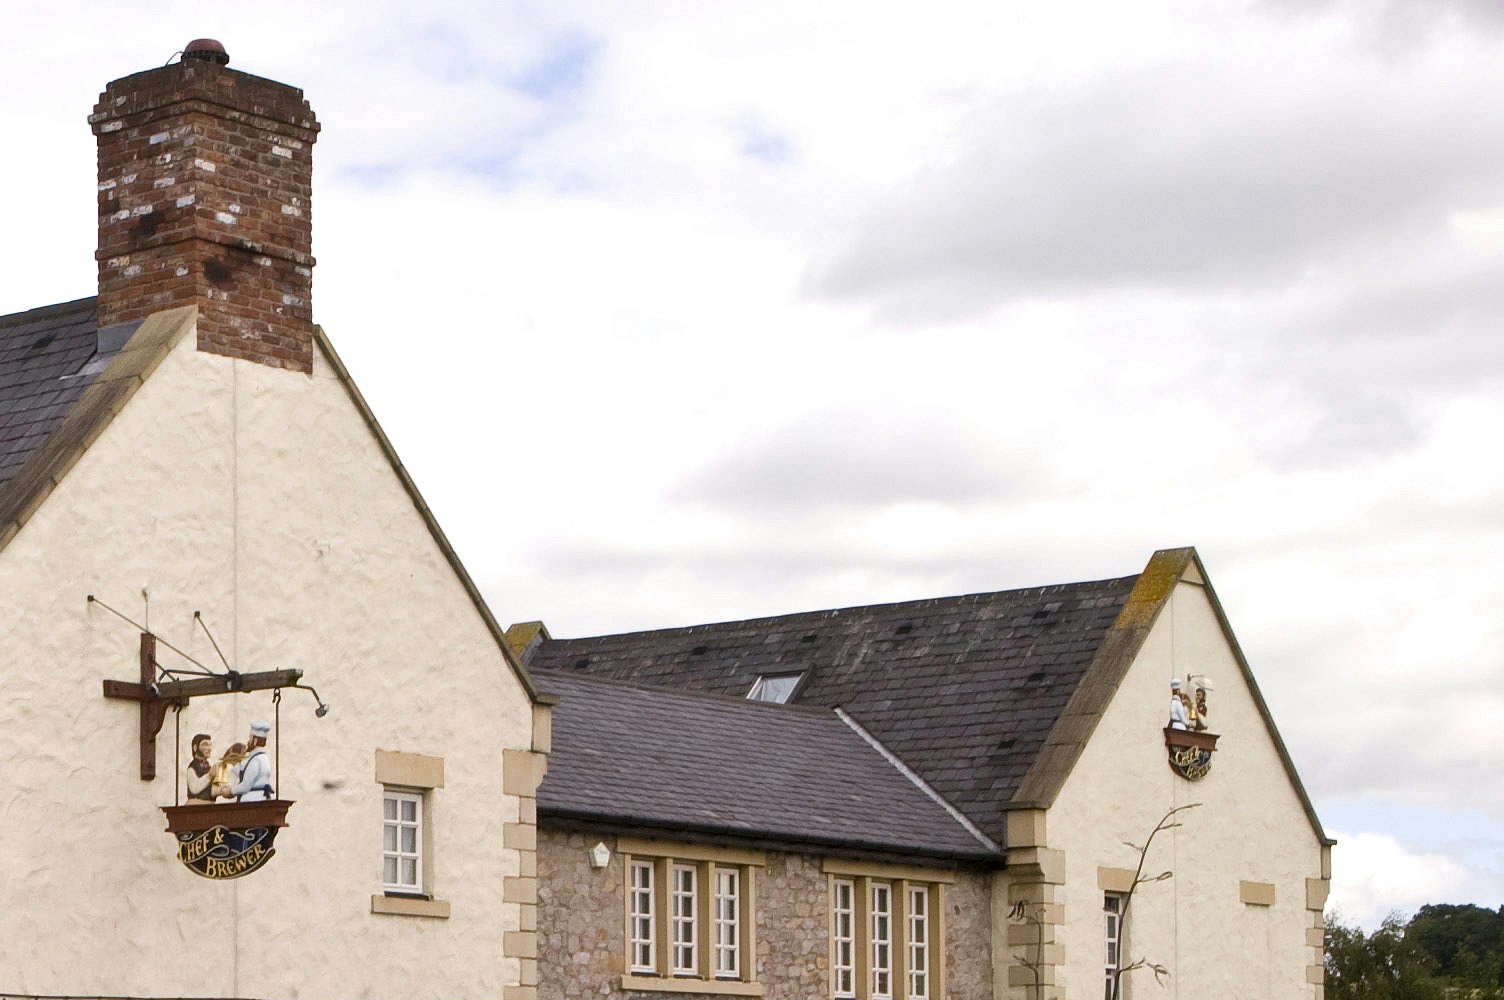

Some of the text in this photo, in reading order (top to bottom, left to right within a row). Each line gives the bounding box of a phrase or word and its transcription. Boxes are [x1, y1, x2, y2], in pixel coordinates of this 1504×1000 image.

[179, 827, 225, 863] CHEF &
[205, 843, 266, 878] BREWER
